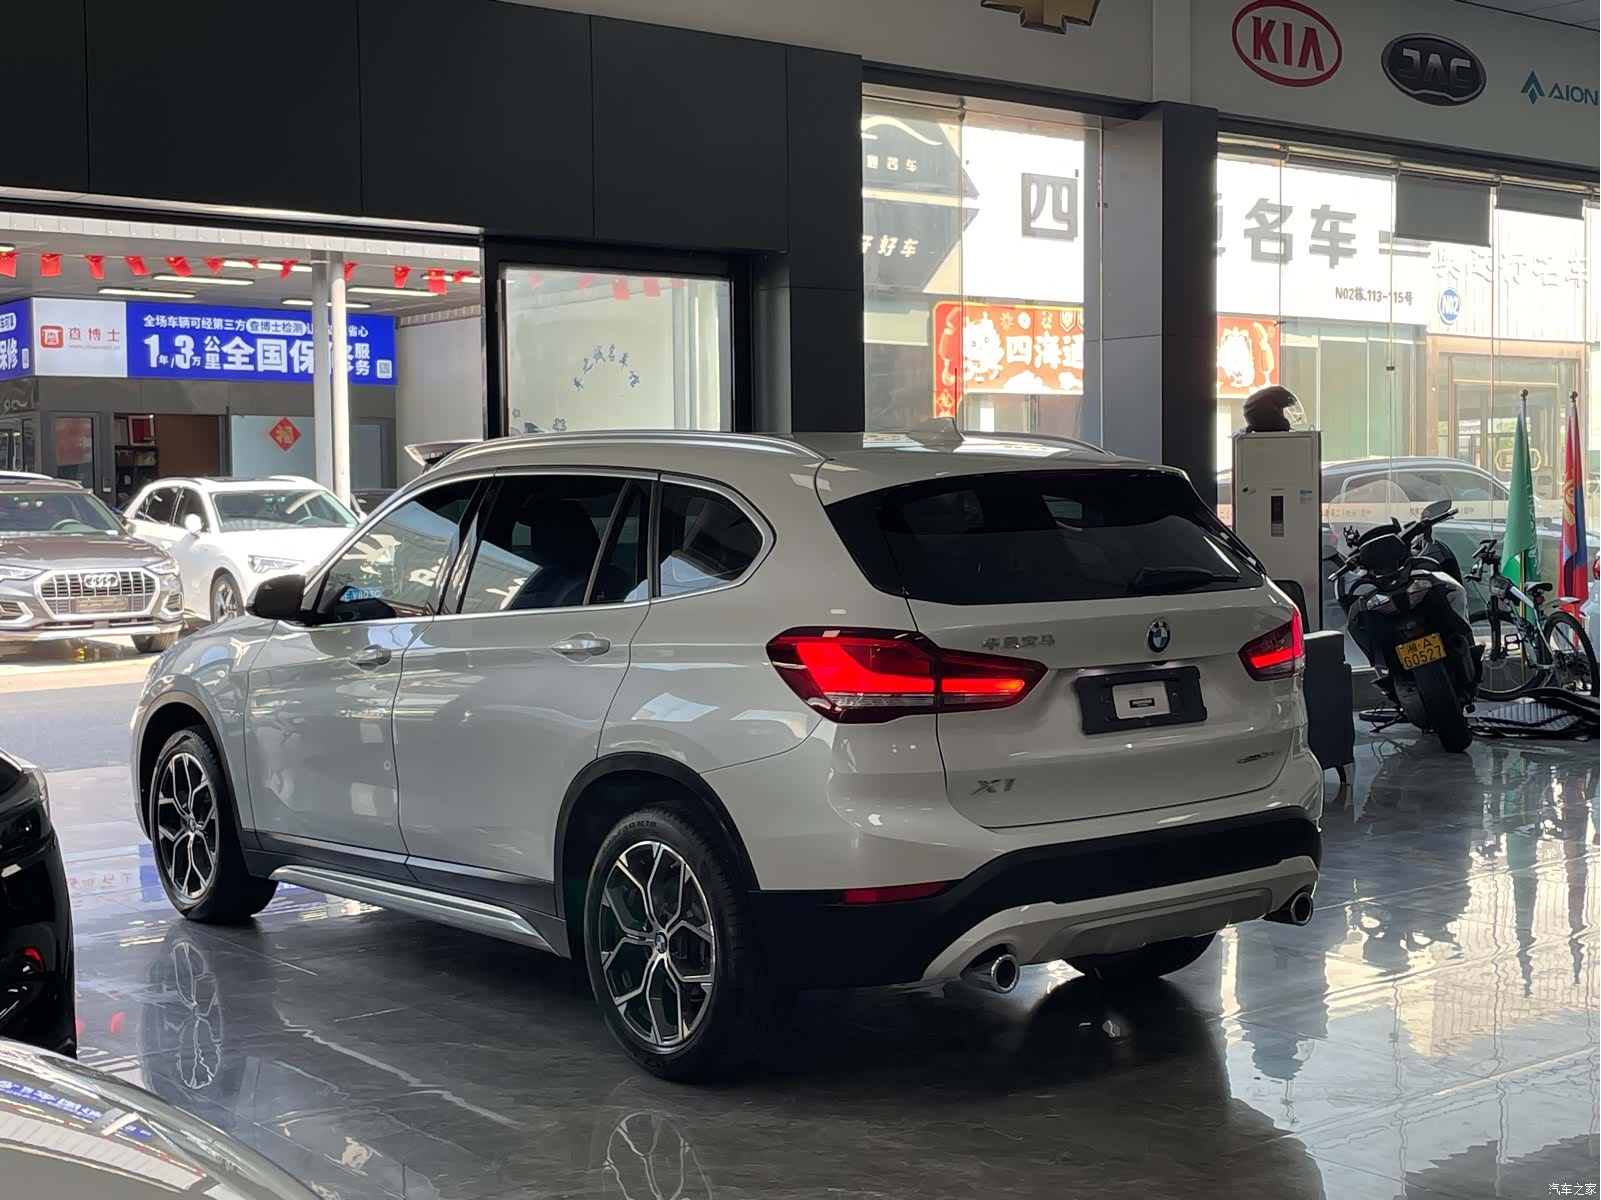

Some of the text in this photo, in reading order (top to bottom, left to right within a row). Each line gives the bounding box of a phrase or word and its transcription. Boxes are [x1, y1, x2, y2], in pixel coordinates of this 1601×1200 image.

[1251, 15, 1325, 72] KIA
[1402, 48, 1471, 86] JAC
[1548, 82, 1599, 106] AION
[1403, 644, 1442, 668] G0527
[969, 778, 1016, 797] X1
